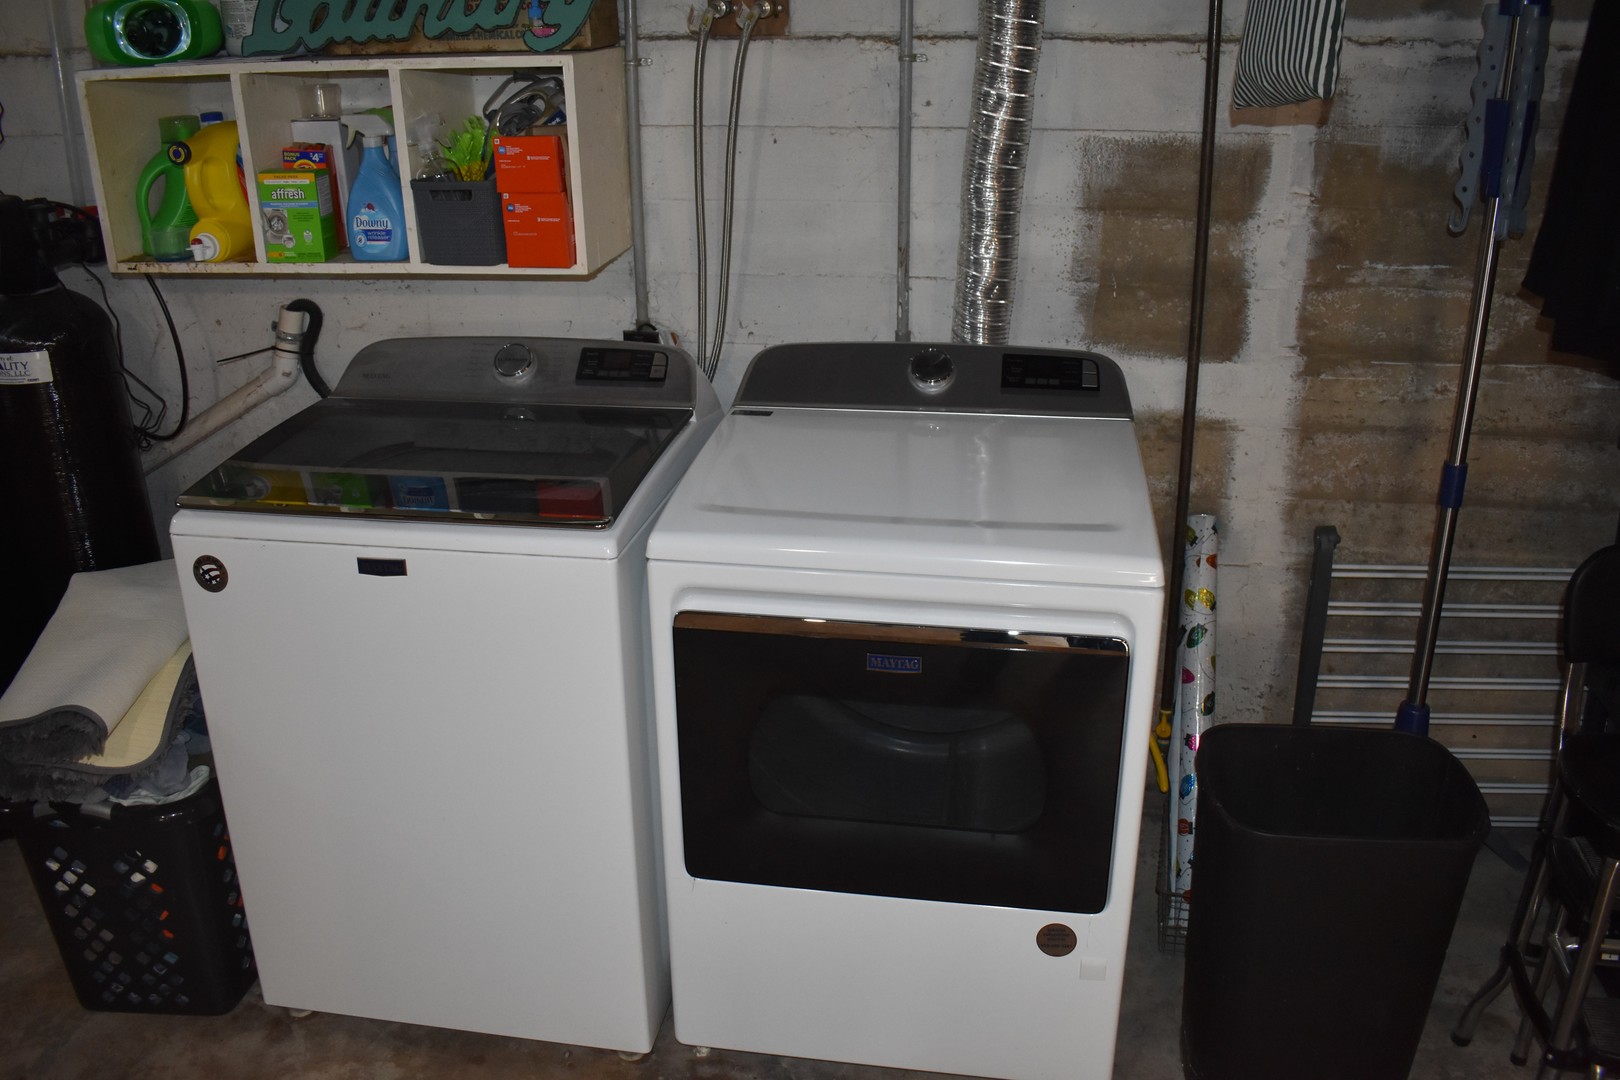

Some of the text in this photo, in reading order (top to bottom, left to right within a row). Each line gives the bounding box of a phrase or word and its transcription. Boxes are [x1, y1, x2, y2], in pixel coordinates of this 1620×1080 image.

[271, 188, 305, 200] affresh
[355, 216, 389, 230] Downy
[870, 657, 919, 669] MAYTAG
